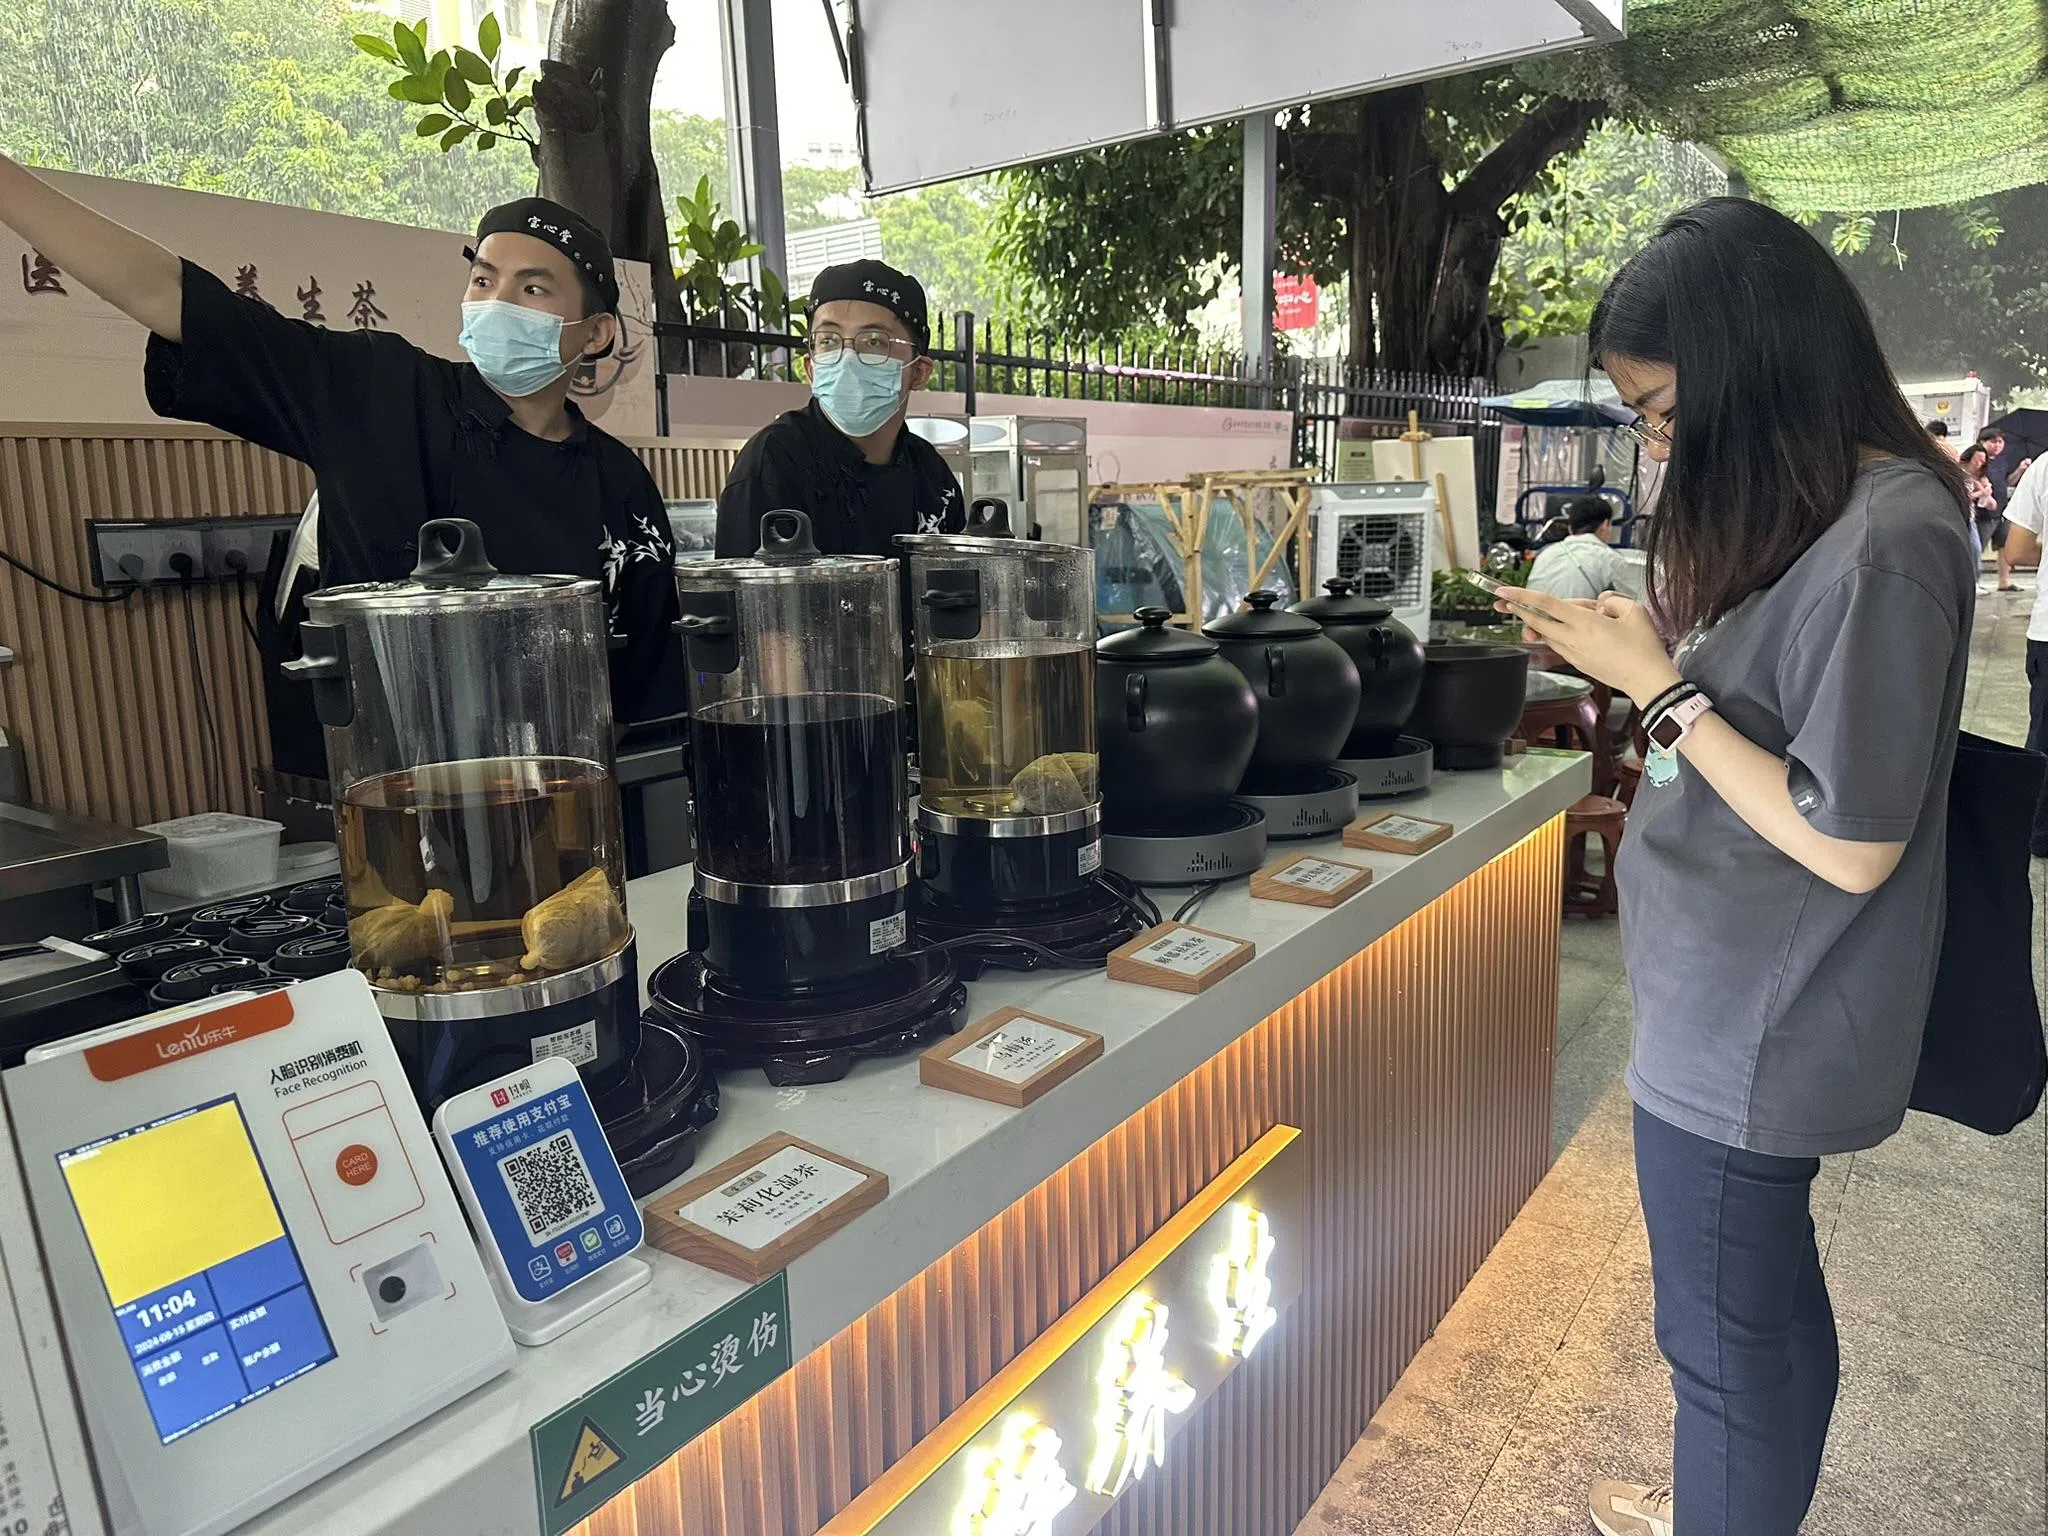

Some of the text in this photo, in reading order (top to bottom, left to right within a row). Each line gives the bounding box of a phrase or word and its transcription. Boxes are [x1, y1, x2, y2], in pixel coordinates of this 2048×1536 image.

[21, 248, 68, 297] 医
[270, 1040, 364, 1085] 人脸识别消费机
[274, 1059, 368, 1098] Face Recognition
[472, 1093, 573, 1149] 推荐使用支付宝
[342, 1152, 369, 1169] CARD
[346, 1161, 372, 1178] HERE
[714, 1163, 819, 1227] 茉莉化湿茶
[136, 1289, 197, 1328] 11:04
[634, 1311, 778, 1437] 当心烫伤
